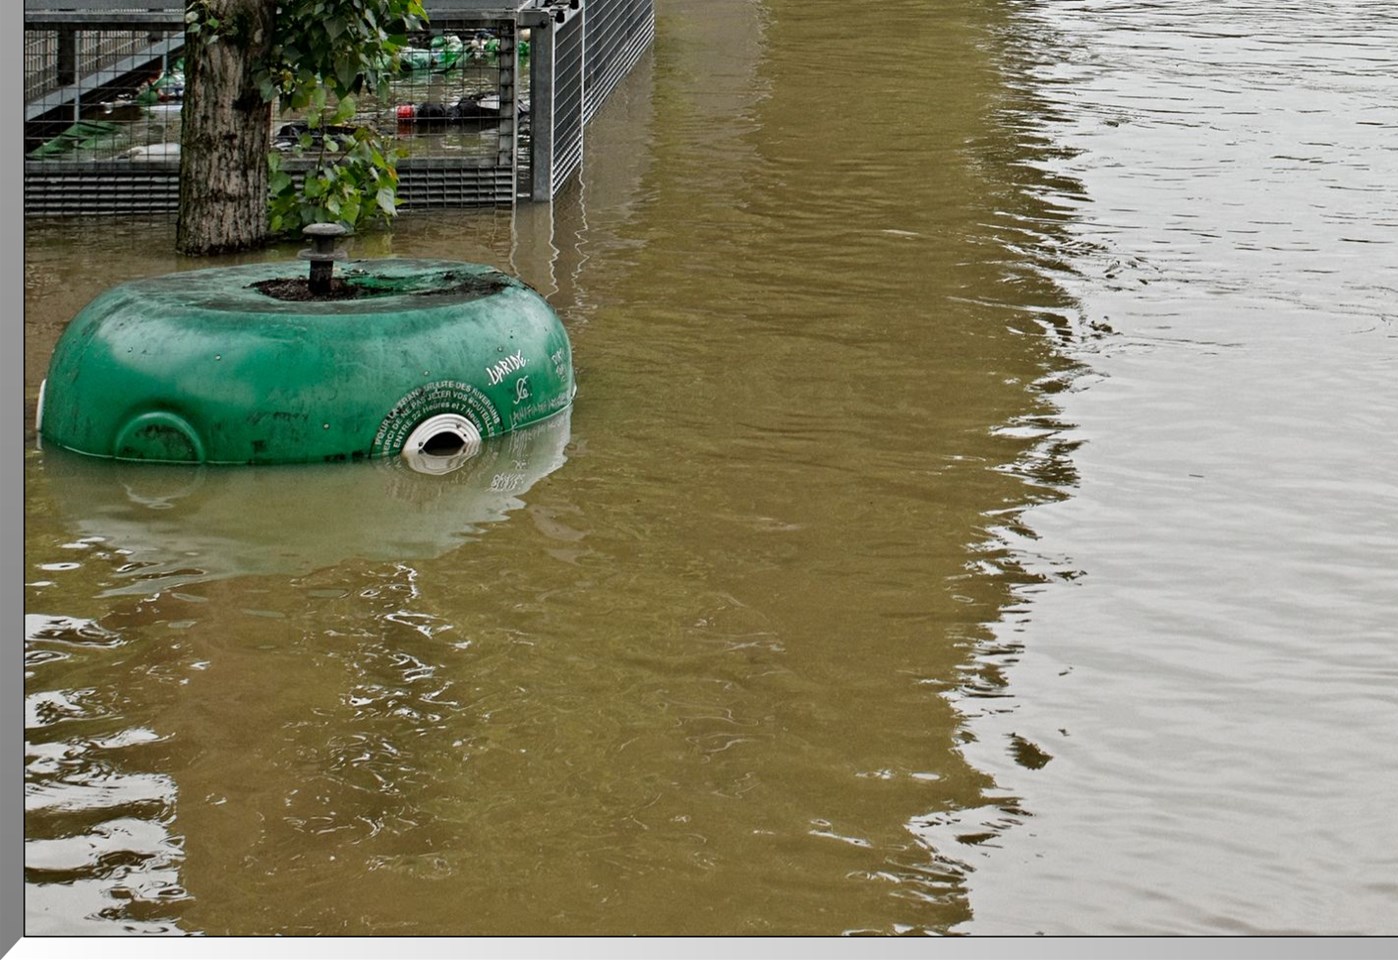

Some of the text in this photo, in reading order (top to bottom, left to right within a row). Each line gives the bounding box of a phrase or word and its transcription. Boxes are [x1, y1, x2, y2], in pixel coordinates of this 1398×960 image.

[375, 419, 391, 445] POUR
[455, 381, 472, 393] DES
[472, 387, 501, 424] RIVERAINS
[392, 417, 403, 430] DE
[411, 396, 427, 409] PAS
[453, 391, 468, 402] VOS
[393, 419, 413, 448] ENTRE
[451, 402, 460, 410] et
[466, 408, 483, 433] Heures
